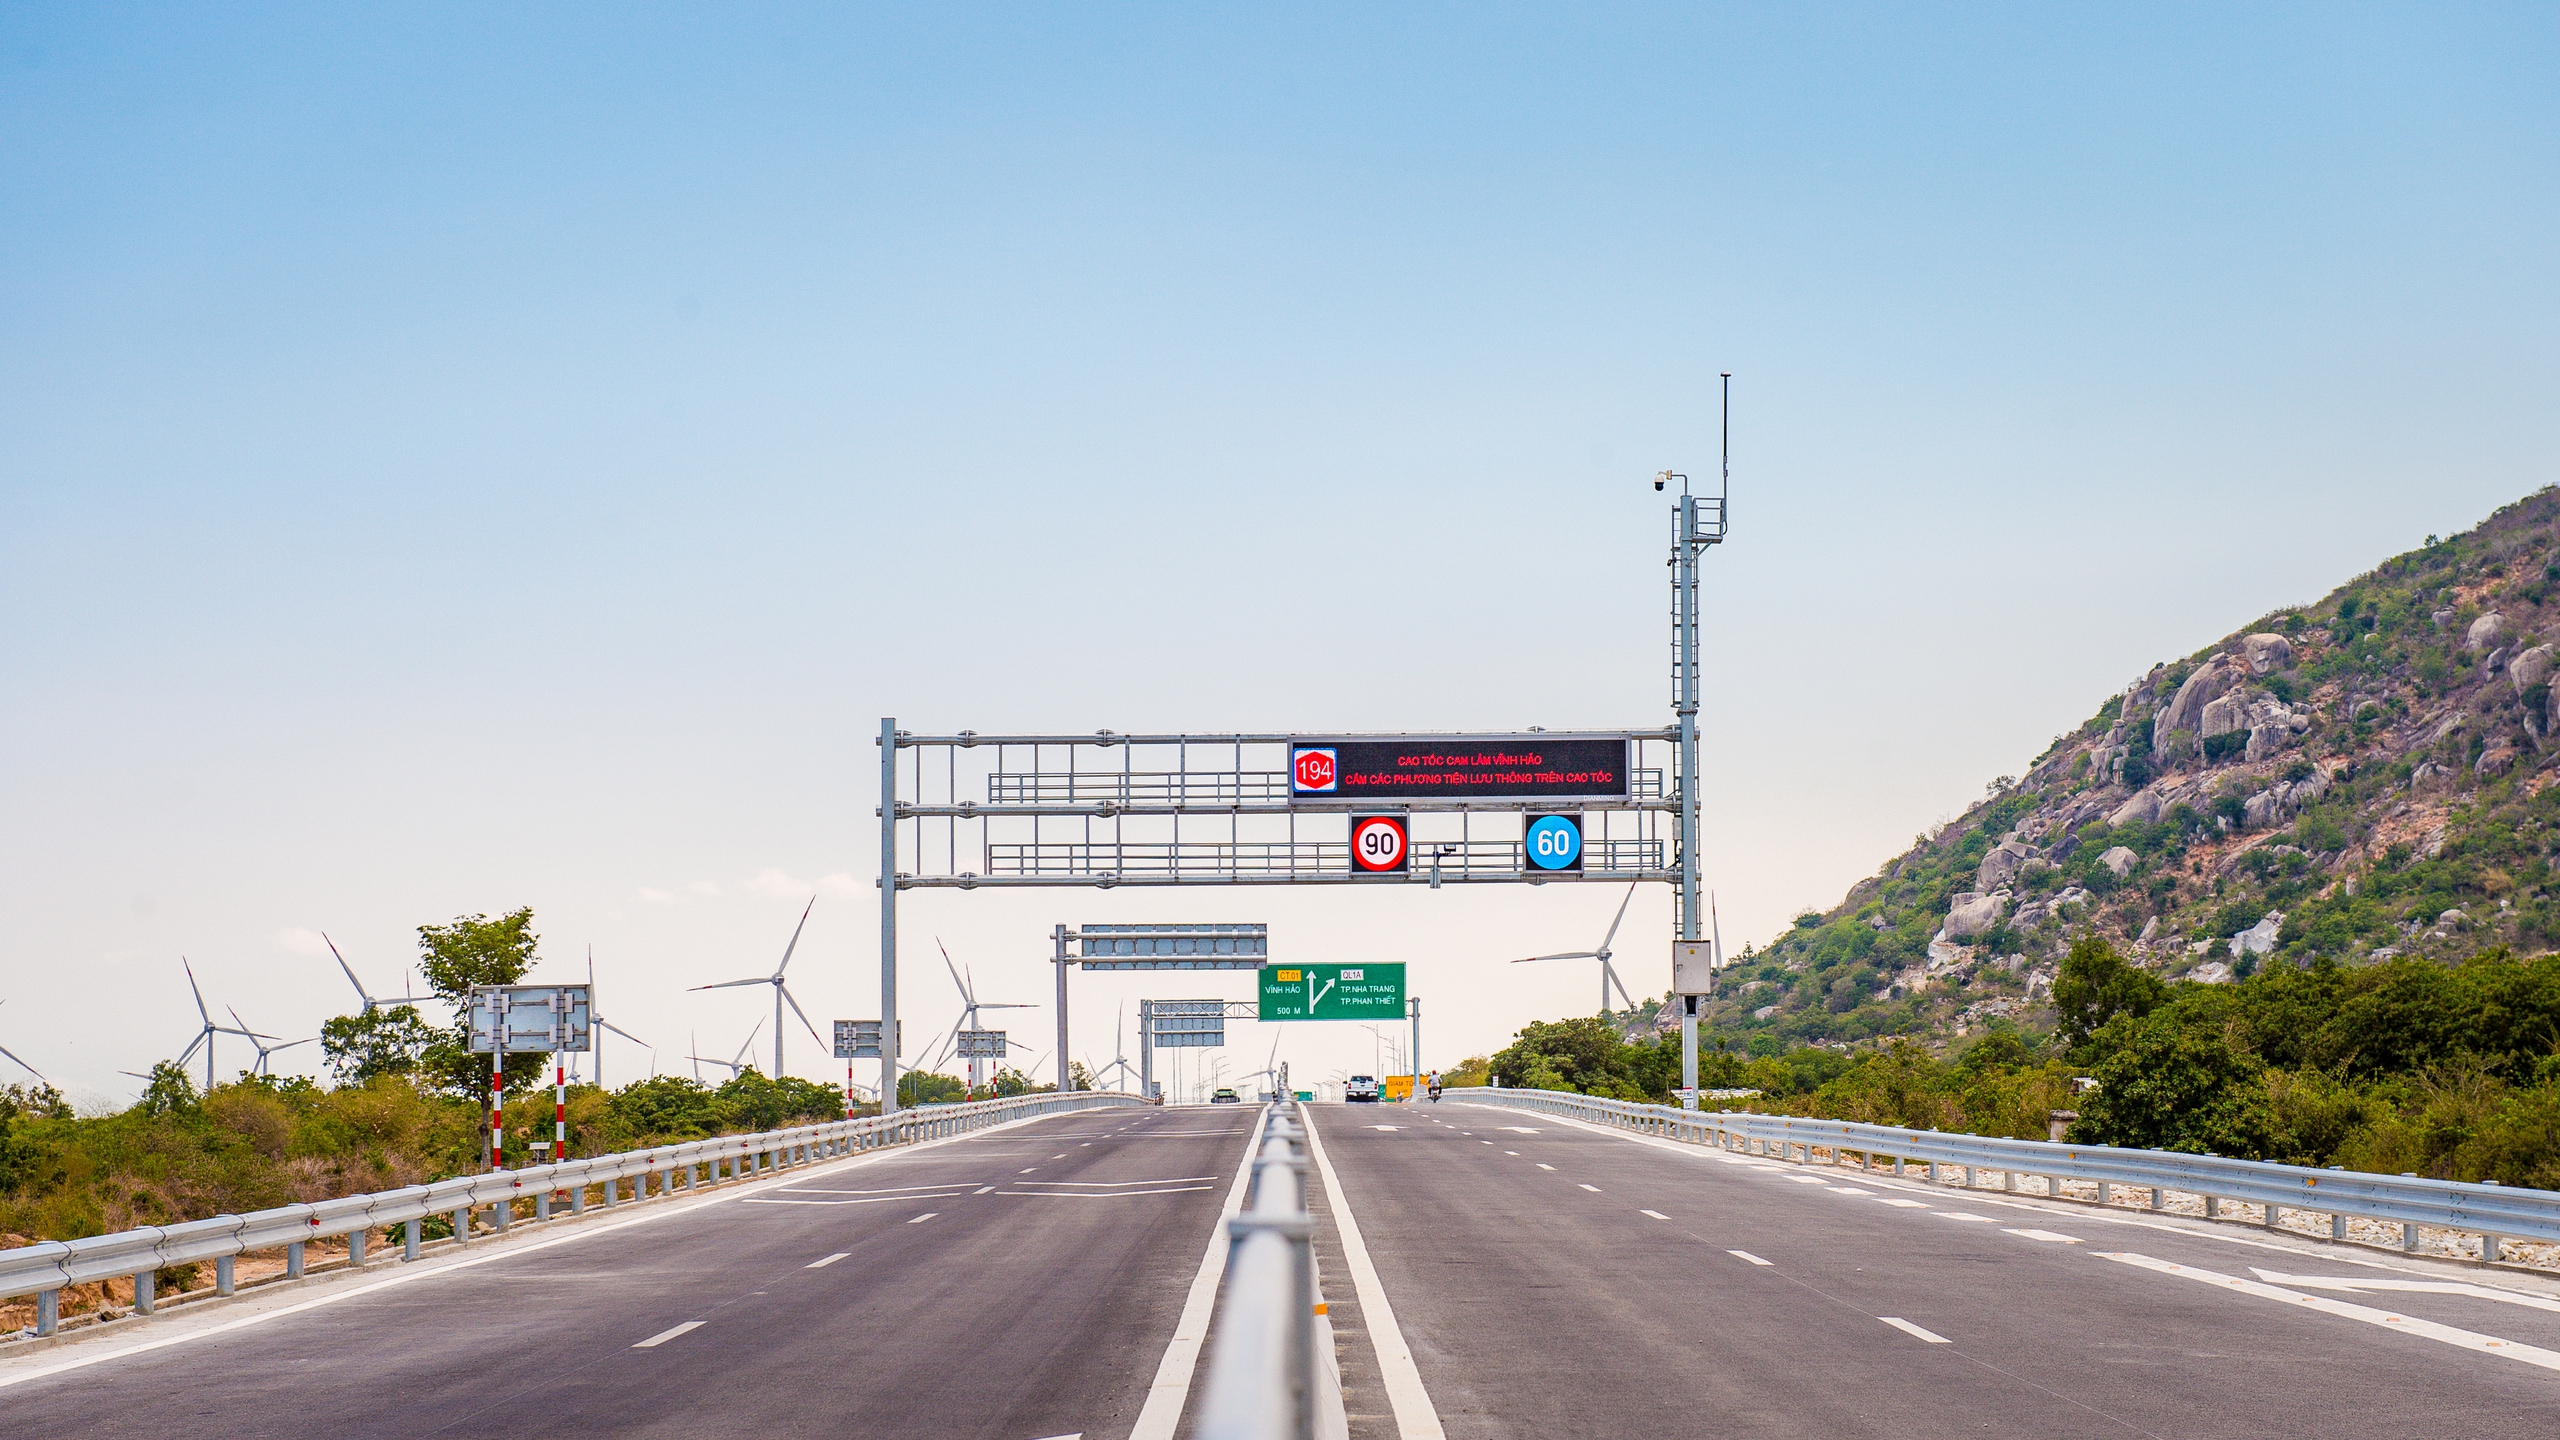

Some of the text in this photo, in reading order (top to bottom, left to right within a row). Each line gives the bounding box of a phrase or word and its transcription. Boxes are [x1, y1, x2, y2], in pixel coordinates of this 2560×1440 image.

[1397, 755, 1420, 766] CAO
[1421, 753, 1444, 766] TỐC
[1446, 755, 1469, 766] CAM
[1470, 753, 1491, 766] LÂM
[1492, 752, 1518, 765] VĨNH
[1299, 760, 1332, 780] 194
[1369, 772, 1392, 785] CÁC
[1393, 773, 1442, 785] PHƯƠNG
[1443, 771, 1468, 786] TIỆN
[1470, 773, 1493, 784] LƯU
[1494, 771, 1533, 784] THÔNG
[1534, 770, 1564, 783] TRÊN
[1566, 772, 1589, 783] CAO
[1590, 769, 1613, 783] TỐC
[1366, 832, 1394, 856] 90
[1537, 829, 1570, 856] 60
[1280, 971, 1299, 980] CT.01
[1342, 971, 1361, 979] QL1A
[1340, 985, 1395, 993] TP.NHA TRANG
[1340, 995, 1396, 1005] TP.PHAN THIẾT
[1277, 1006, 1301, 1015] 500 M
